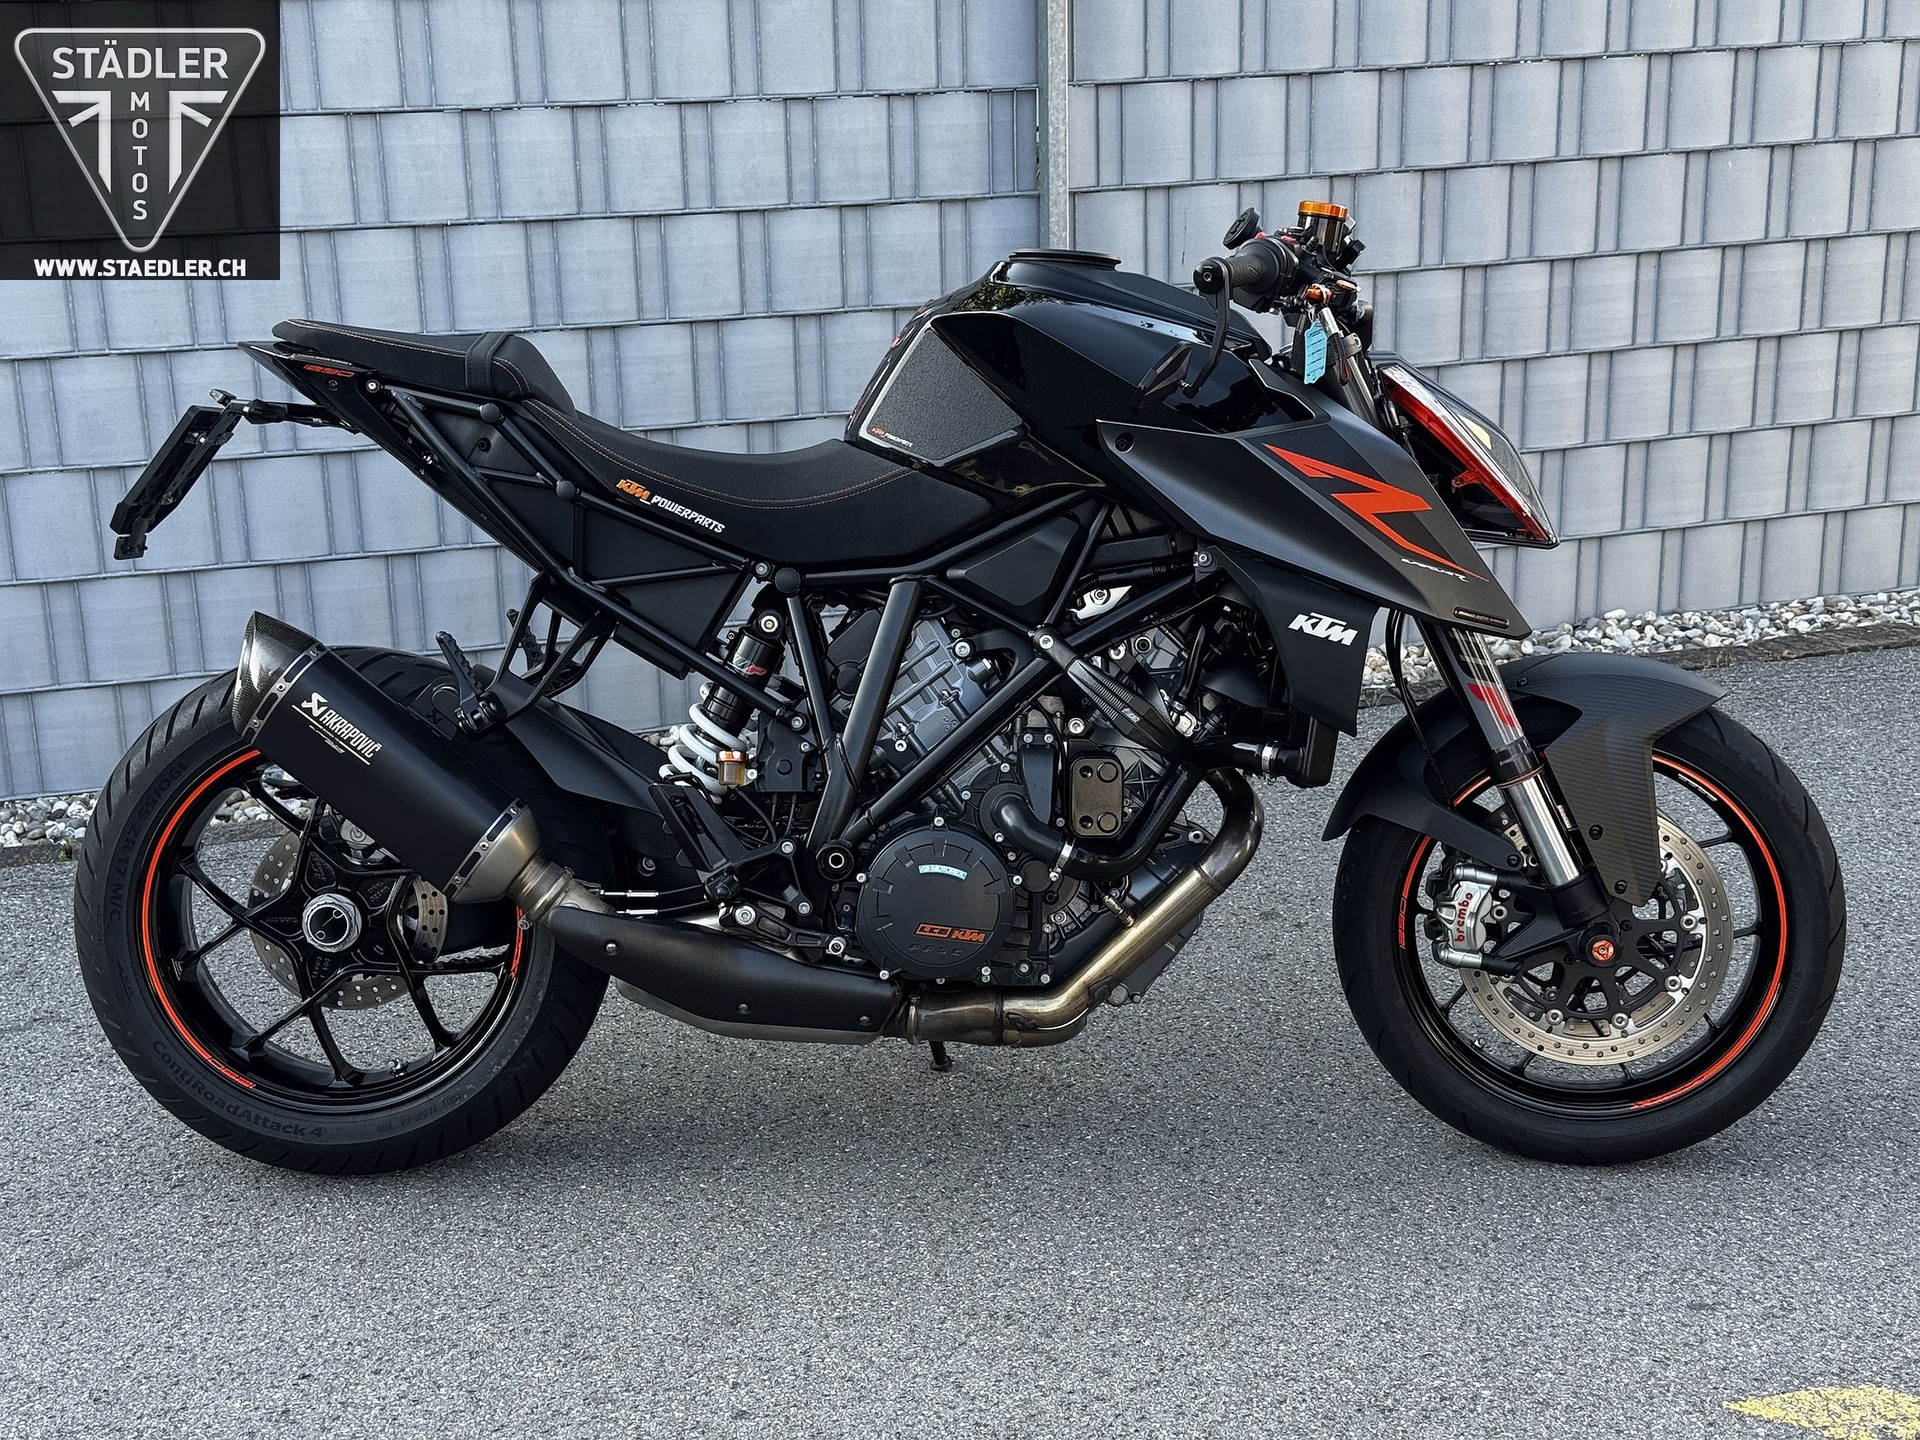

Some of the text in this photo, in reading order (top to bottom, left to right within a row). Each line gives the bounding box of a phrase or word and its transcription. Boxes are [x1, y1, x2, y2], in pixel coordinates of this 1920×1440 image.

[1288, 612, 1358, 646] KTM
[120, 824, 143, 853] ZR
[108, 883, 127, 924] M/C
[1455, 892, 1473, 942] brembo
[152, 1040, 325, 1138] ContiRoadAttack 4
